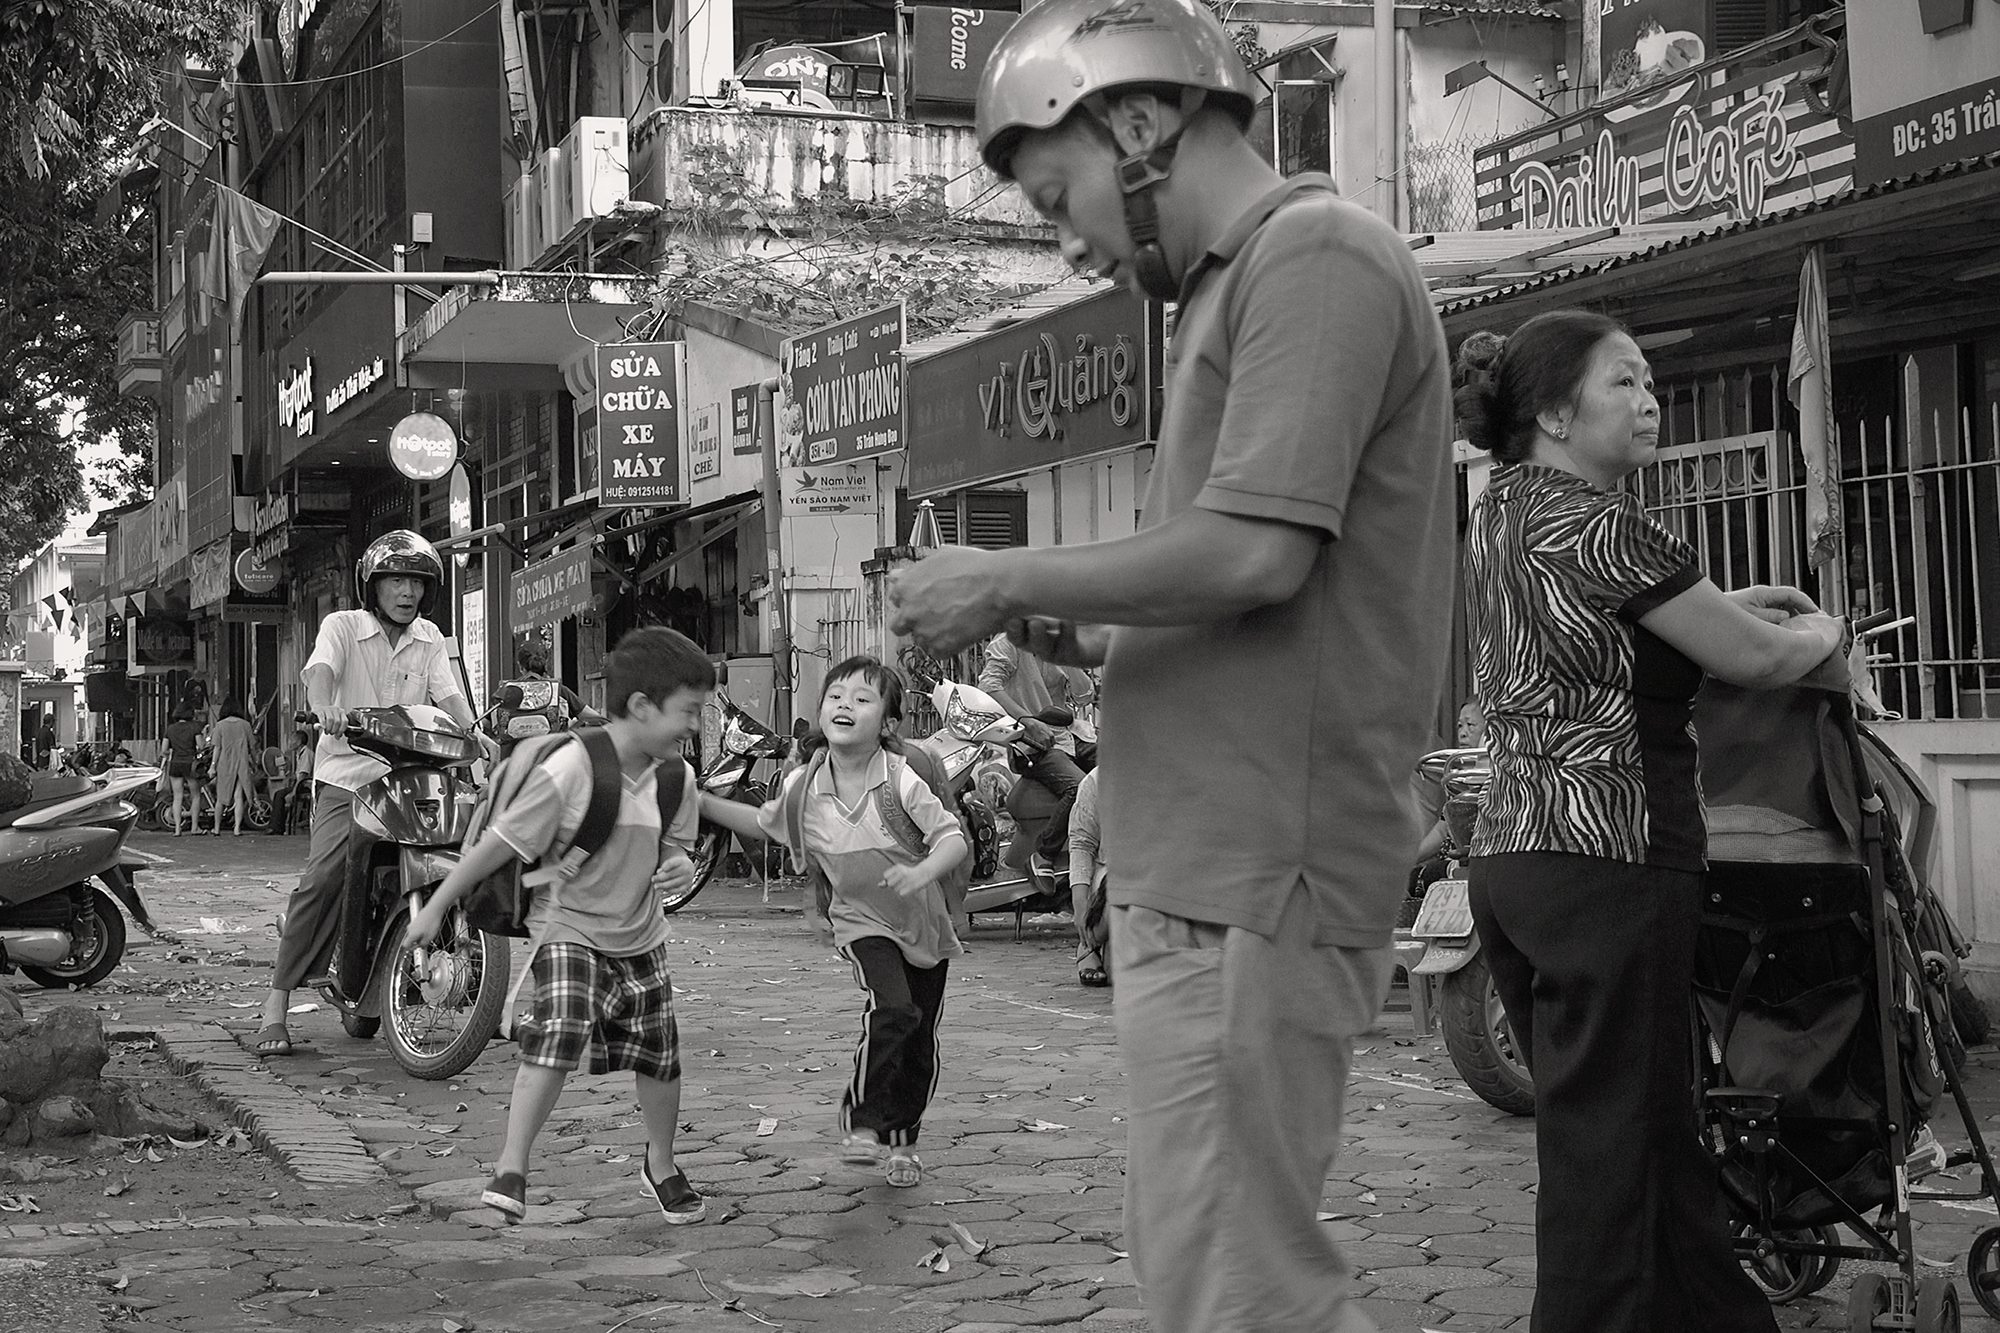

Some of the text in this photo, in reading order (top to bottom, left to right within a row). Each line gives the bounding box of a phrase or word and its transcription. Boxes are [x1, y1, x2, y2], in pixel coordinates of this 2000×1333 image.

[1893, 120, 1927, 157] ĐC:
[1931, 108, 1957, 145] 35
[610, 350, 661, 378] SỬA
[811, 342, 817, 364] 2
[602, 385, 673, 412] CHỮA
[807, 375, 830, 436] CƠM
[831, 360, 857, 429] VĂN
[858, 352, 899, 423] PHÒNG
[1016, 332, 1133, 440] Quảng
[622, 424, 655, 445] XE
[613, 452, 666, 479] MÁY
[627, 485, 674, 498] 0912514181
[820, 475, 866, 486] Nam Viet
[830, 495, 850, 503] NAM
[852, 493, 872, 504] VIỆT
[553, 570, 565, 594] XE
